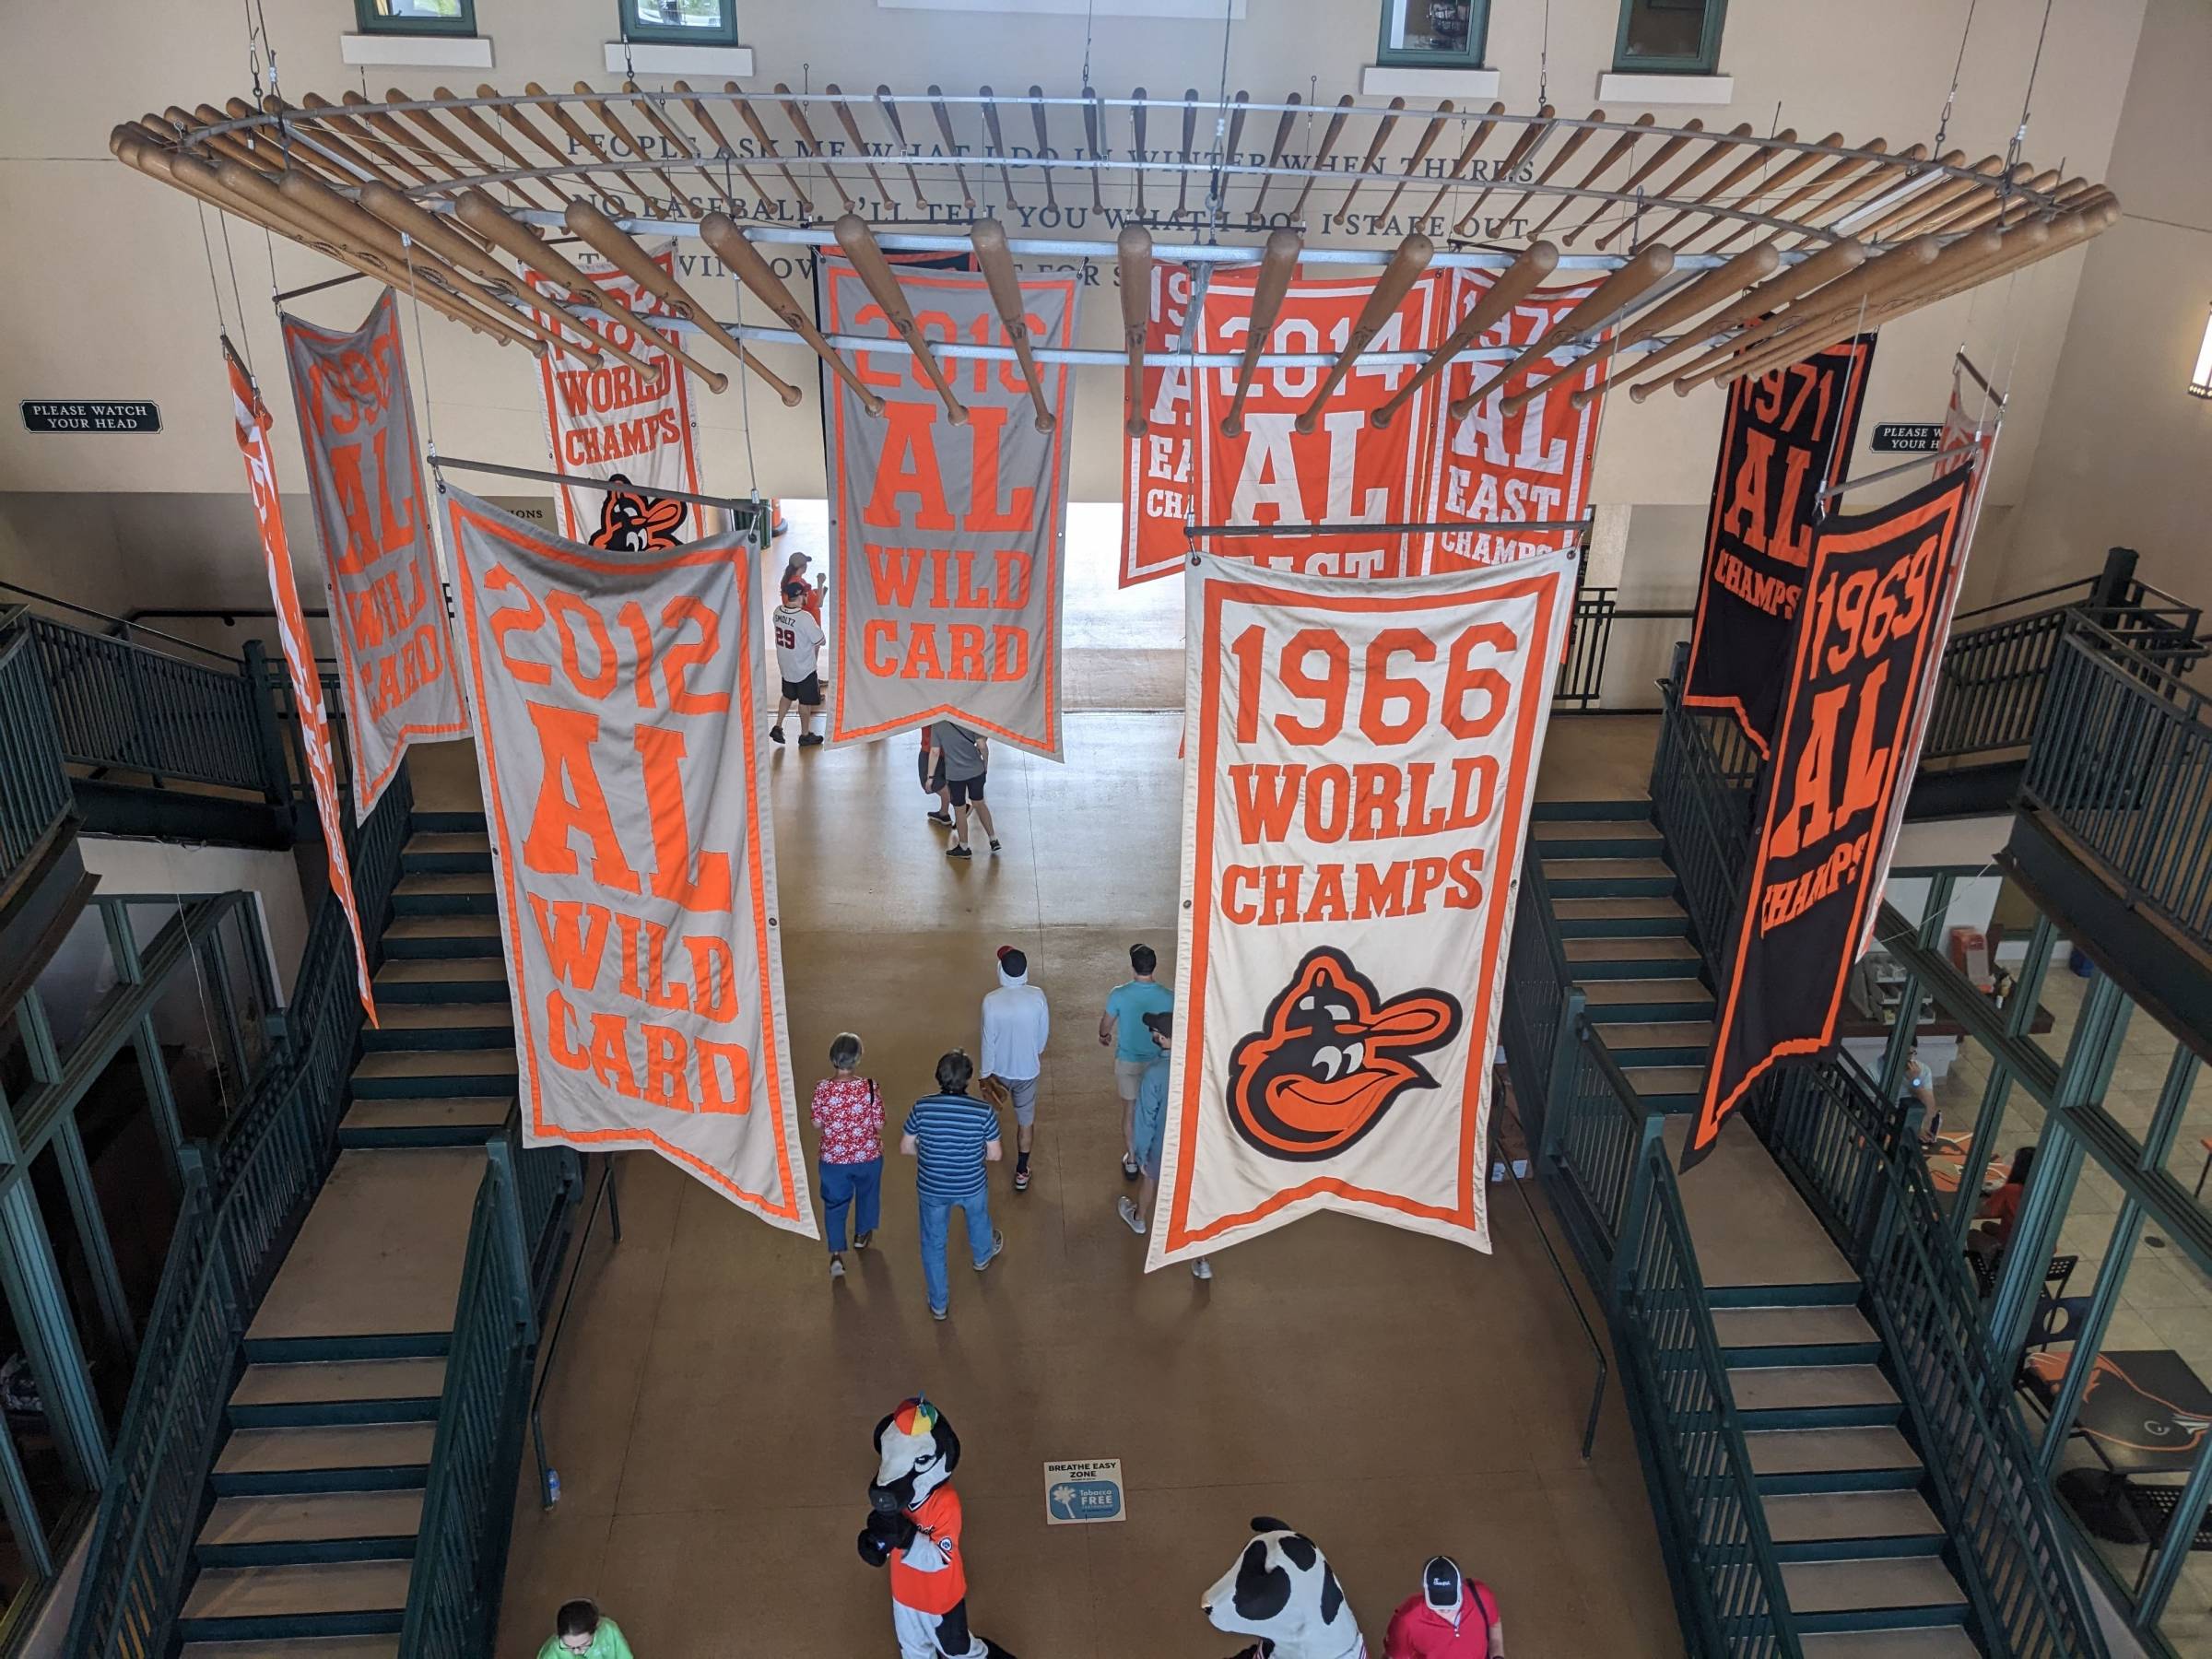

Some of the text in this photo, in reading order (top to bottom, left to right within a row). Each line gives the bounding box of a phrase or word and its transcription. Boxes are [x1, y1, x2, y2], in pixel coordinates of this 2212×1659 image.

[795, 140, 845, 159] ME
[864, 143, 971, 165] WHAT
[985, 146, 995, 168] I
[1011, 147, 1059, 170] DO
[1127, 150, 1271, 175] WINTER
[1281, 154, 1386, 176] WHEN
[1400, 157, 1534, 182] THERES
[572, 194, 625, 218] NO
[927, 205, 1002, 225] TELL
[1017, 206, 1088, 229] YOU
[1104, 208, 1206, 230] WHAT
[1321, 214, 1333, 234] I
[1346, 215, 1445, 237] STARE
[1461, 218, 1528, 239] OUT
[854, 304, 1046, 394] 2016
[1219, 312, 1404, 398] 2014
[33, 406, 148, 416] PLEASE WATCH
[557, 354, 671, 418] WORLD
[1452, 361, 1568, 475] AL
[1744, 361, 1835, 441] 1971
[47, 418, 138, 429] YOUR HEAD
[565, 408, 681, 466] CHAMPS
[1883, 428, 1928, 437] PLEASE
[1891, 440, 1926, 449] YOUR
[330, 427, 415, 575] AL
[863, 401, 1034, 532] AL
[1224, 411, 1389, 537] AL
[1445, 465, 1561, 533] EAST
[1724, 427, 1812, 568] AL
[864, 544, 1032, 609] WILD
[1714, 548, 1803, 620] CHAMPS
[1809, 534, 1939, 681] 1969
[485, 563, 730, 713] 2012
[775, 615, 796, 627] SMOLTZ
[775, 626, 795, 650] 29
[864, 618, 1030, 682] CARD
[1230, 620, 1519, 747] 1966
[1770, 657, 1891, 858] AL
[523, 700, 733, 913] AL
[1228, 754, 1500, 846] WORLD
[1220, 847, 1485, 926] CHAMPS
[529, 891, 739, 1023] WILD
[547, 989, 751, 1115] CARD
[1048, 1462, 1117, 1472] BREATHE EASY
[1070, 1470, 1097, 1478] ZONE
[1079, 1488, 1112, 1497] Tobacco
[1081, 1496, 1113, 1505] FREE
